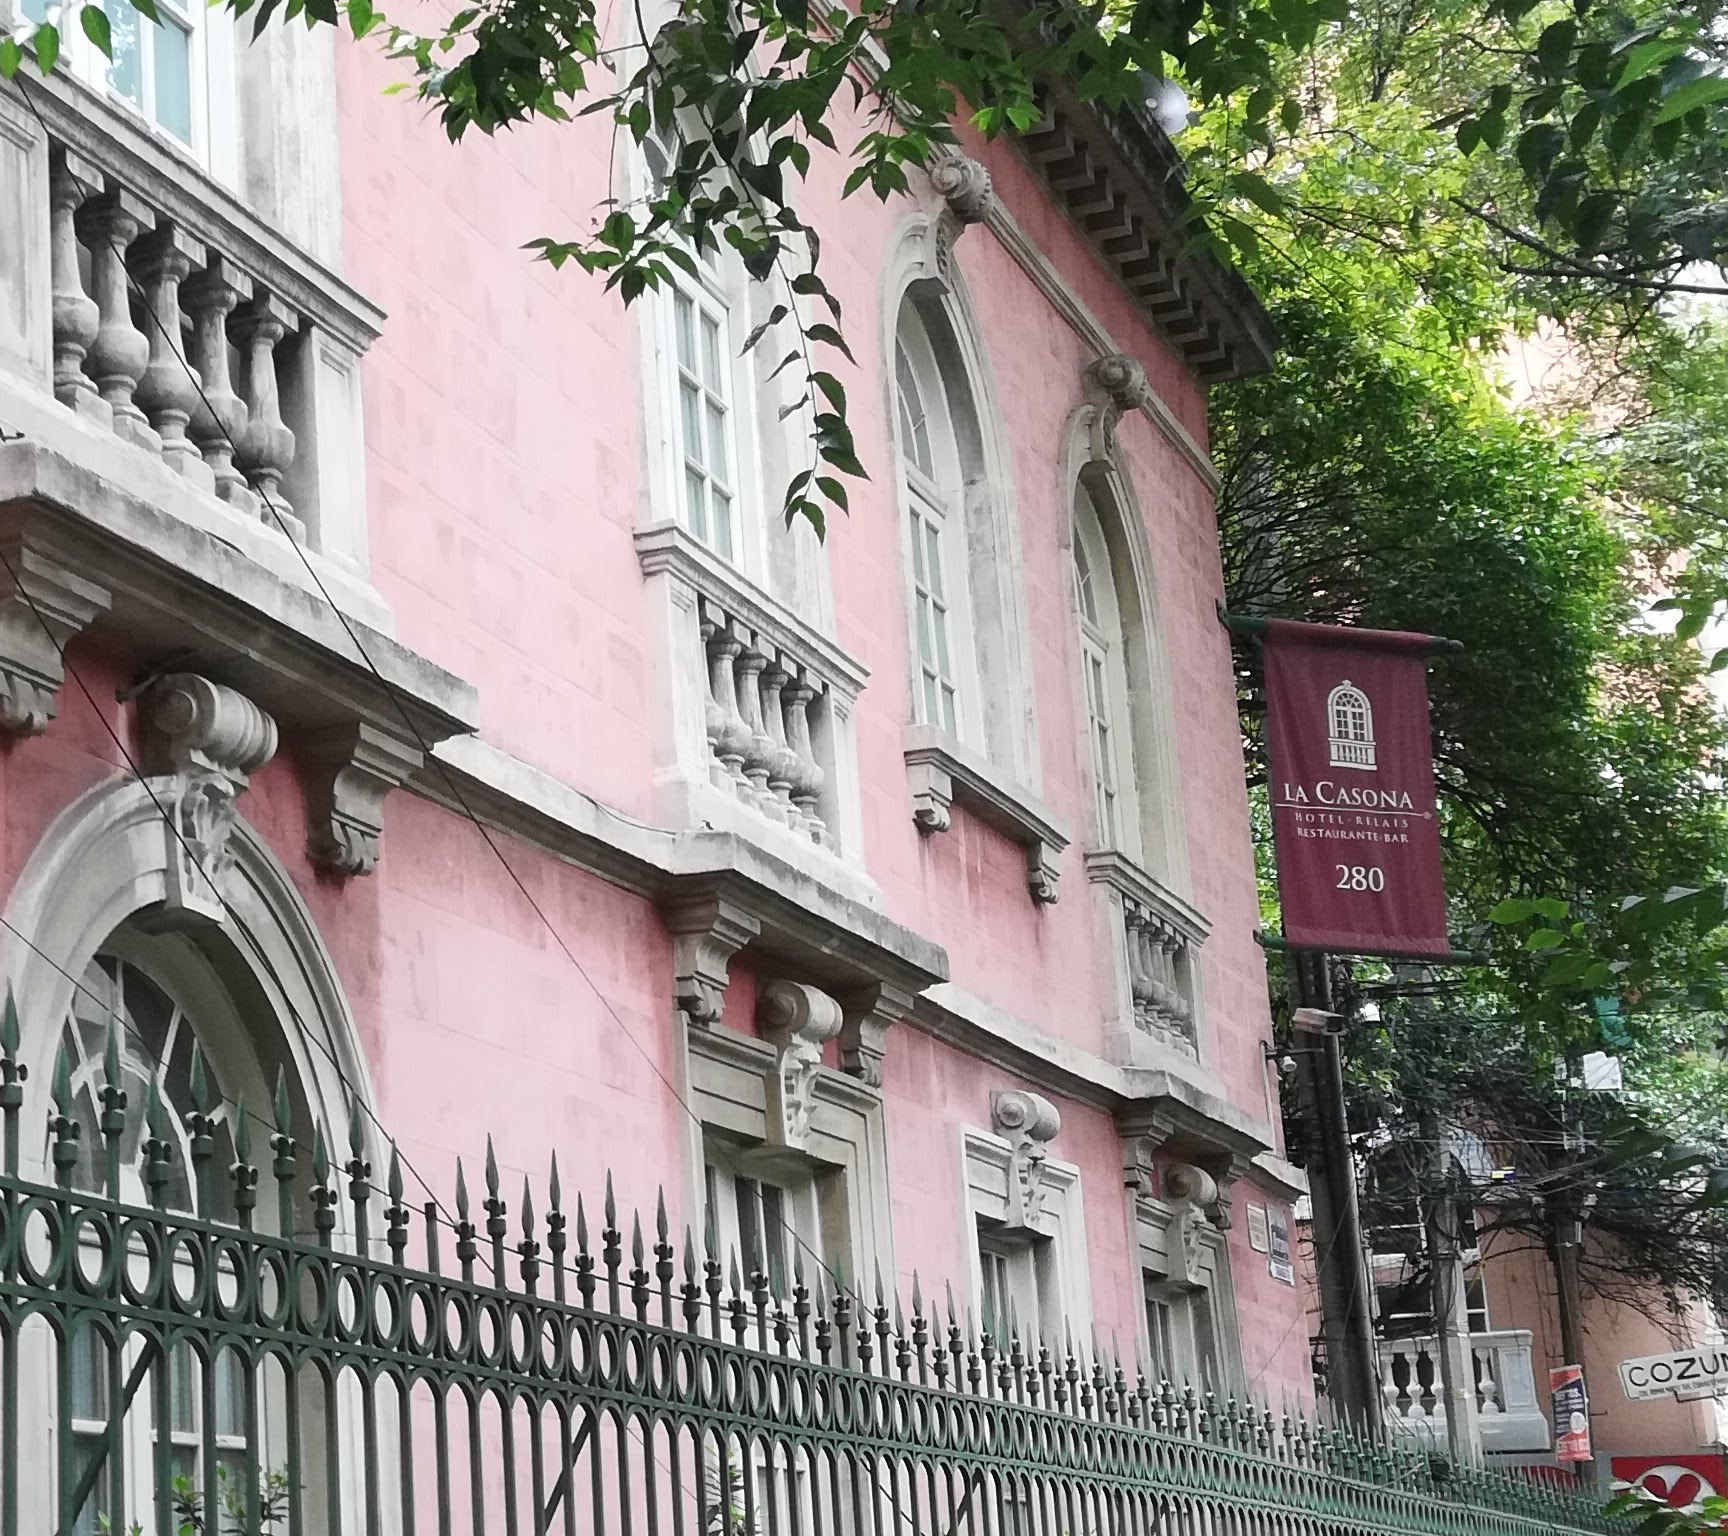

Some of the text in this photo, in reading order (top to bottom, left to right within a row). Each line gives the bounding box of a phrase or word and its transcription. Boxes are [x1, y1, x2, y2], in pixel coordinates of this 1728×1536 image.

[1284, 780, 1414, 809] LA CASONA
[1297, 827, 1409, 843] RESTAURANTE-BAR
[1335, 864, 1385, 892] 280
